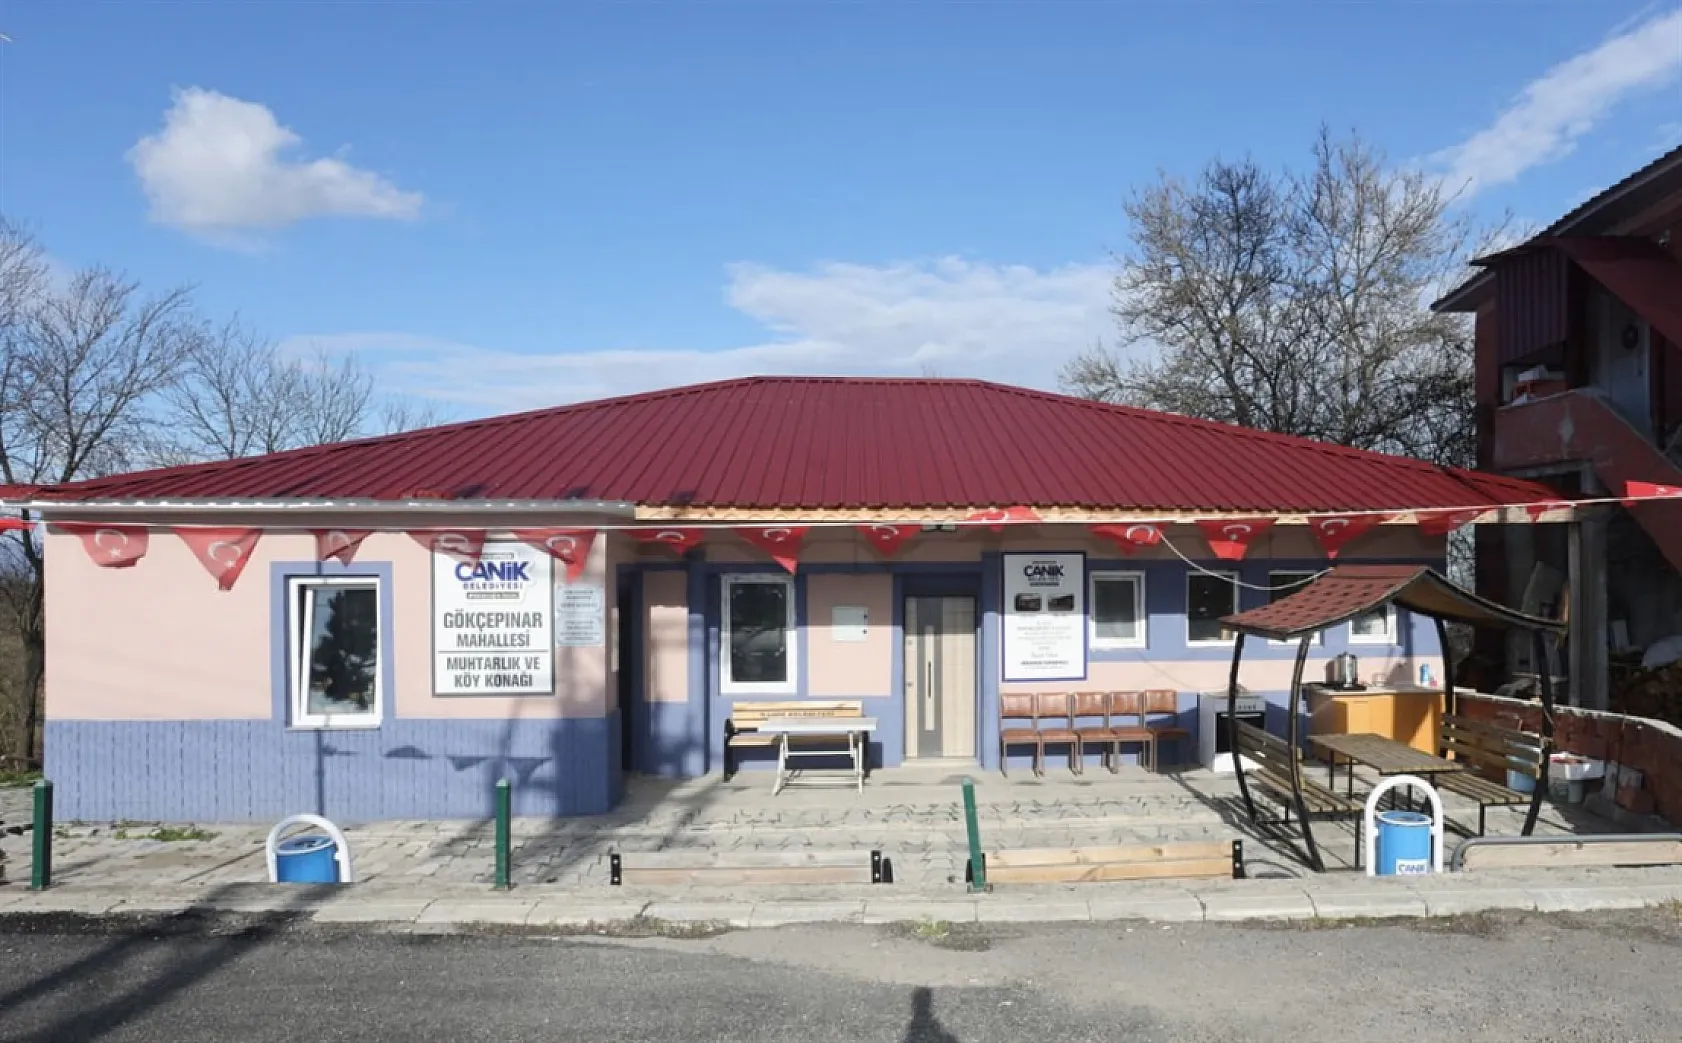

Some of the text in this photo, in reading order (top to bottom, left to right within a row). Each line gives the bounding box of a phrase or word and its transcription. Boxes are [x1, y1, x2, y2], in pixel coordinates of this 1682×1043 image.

[443, 608, 543, 632] GÖKÇEPINAR
[456, 629, 530, 647] MAHALLESİ
[446, 657, 541, 671] MUHTARLIK VE
[454, 672, 533, 687] KÖY KONAĞI
